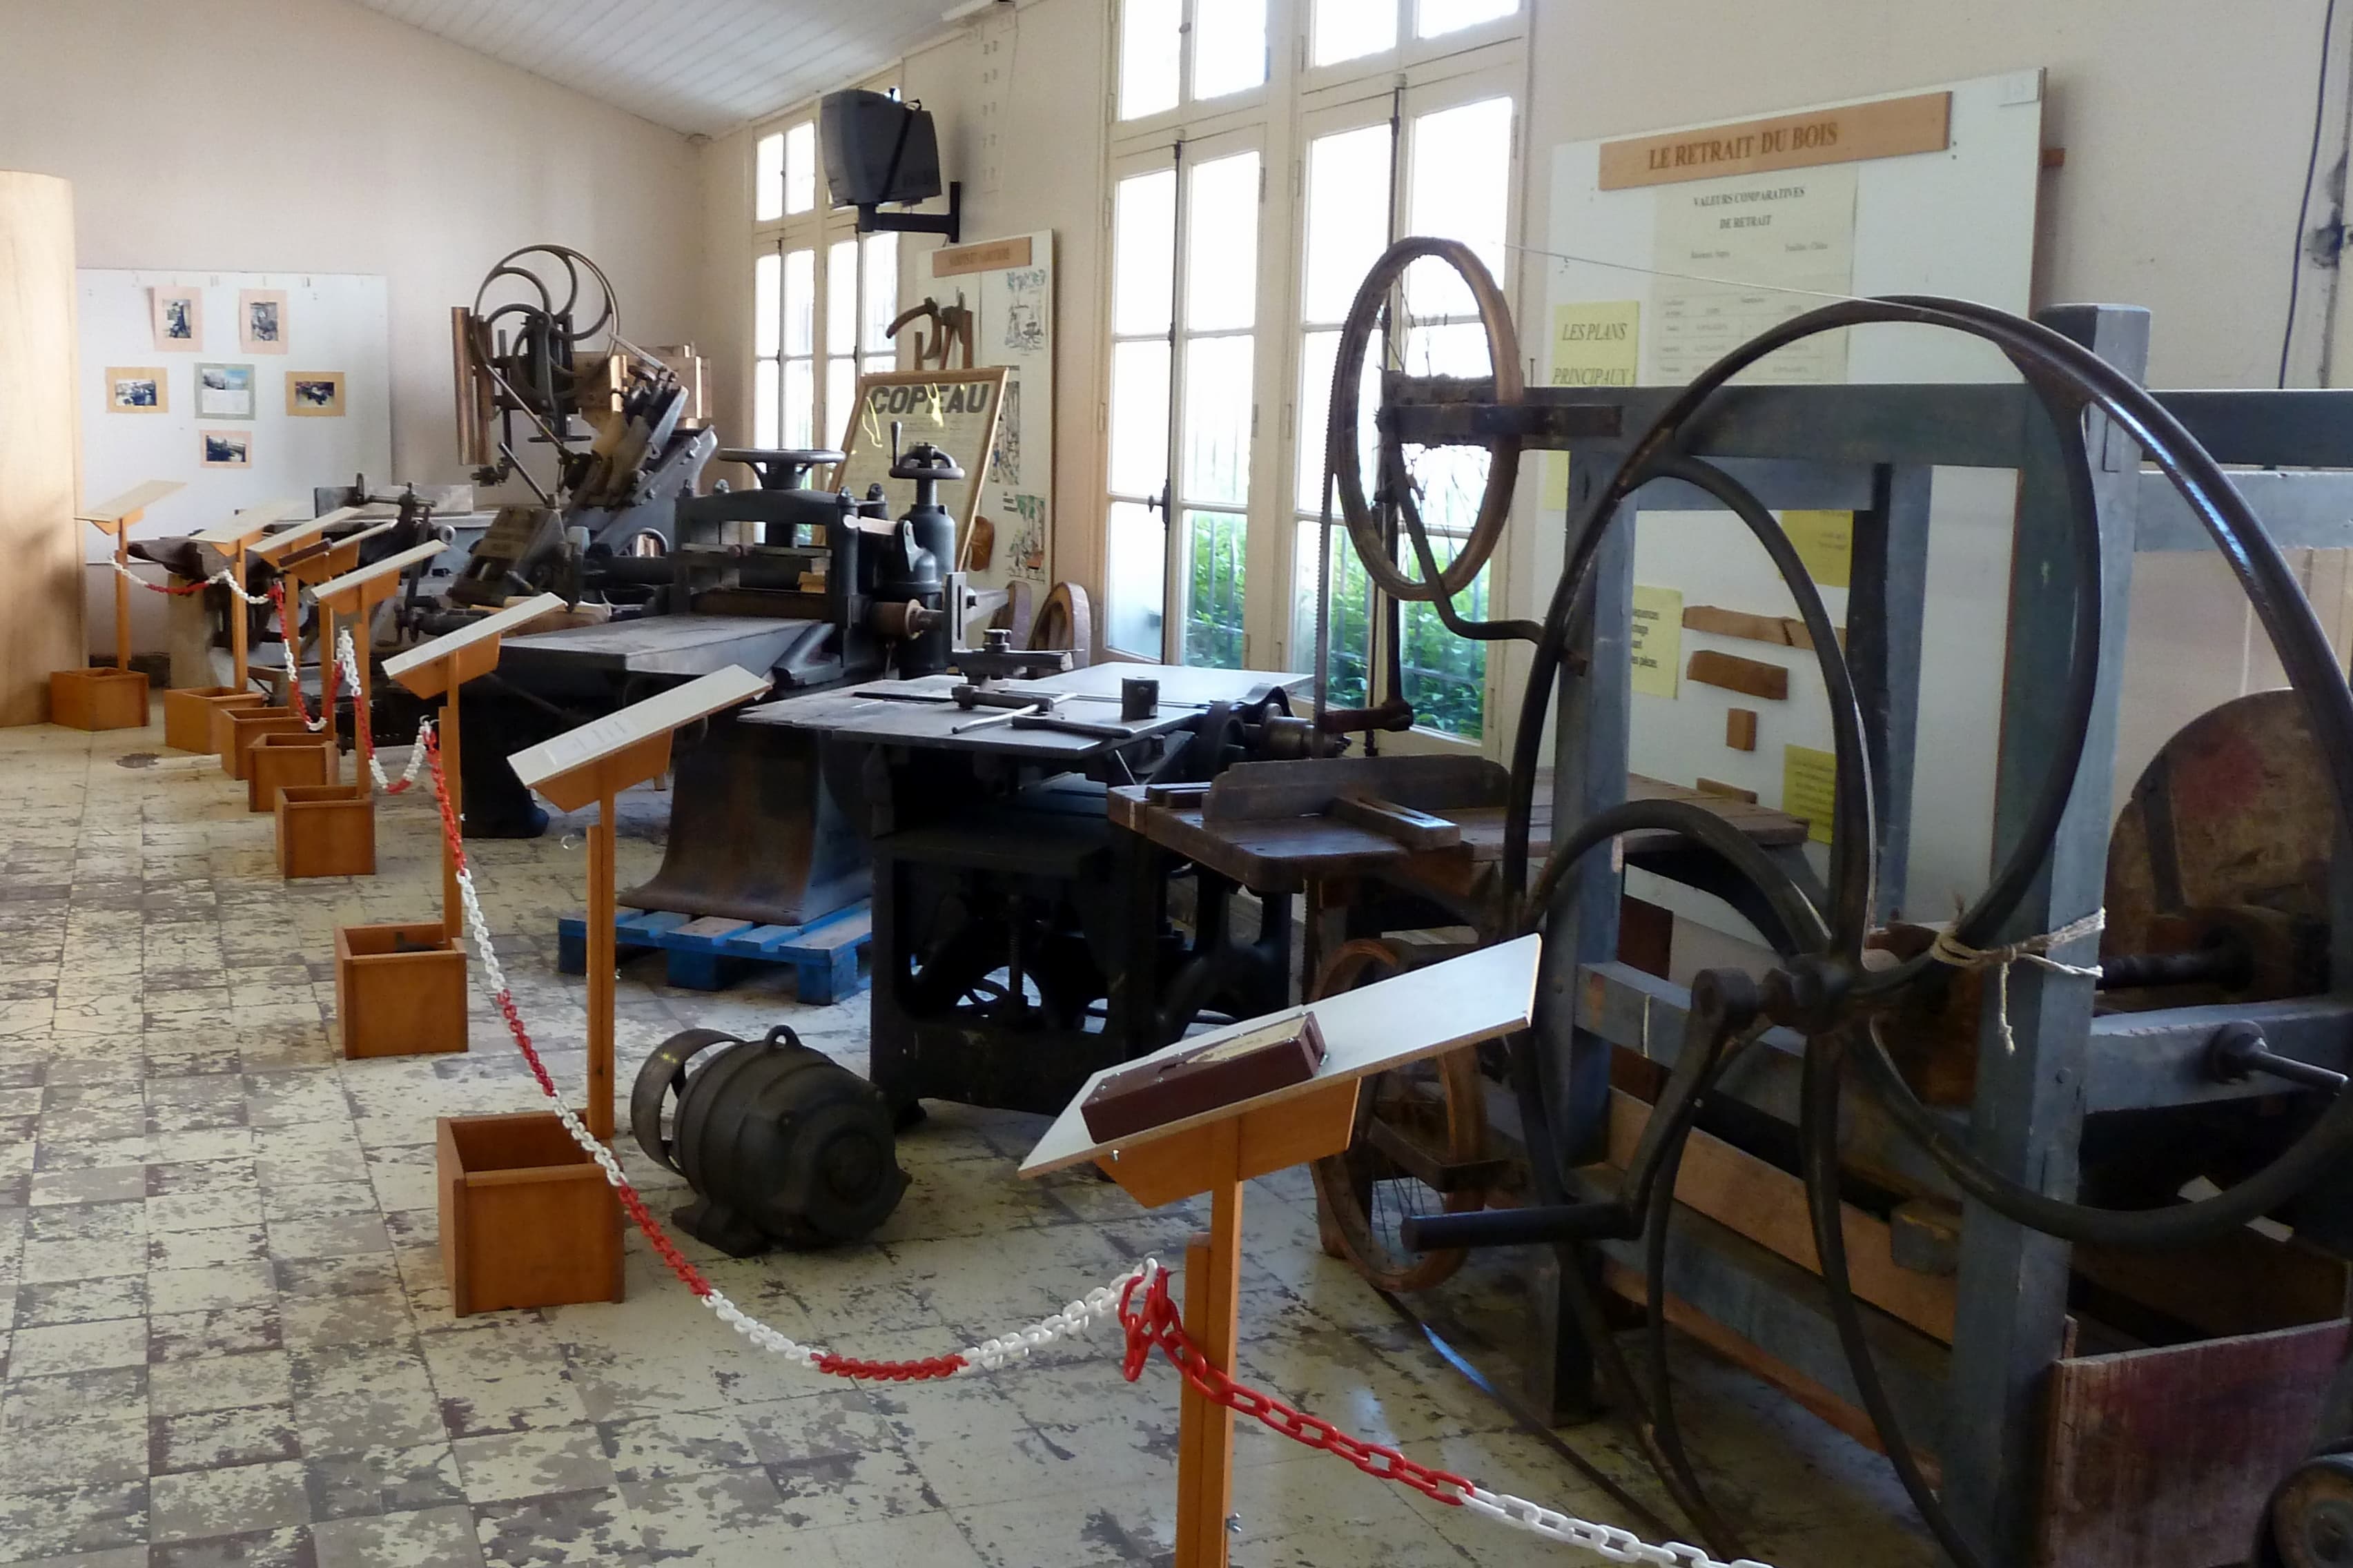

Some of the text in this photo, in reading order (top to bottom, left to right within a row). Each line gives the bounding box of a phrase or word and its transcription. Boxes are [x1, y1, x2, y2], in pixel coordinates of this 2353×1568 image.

[1649, 121, 1838, 170] LE RETRAIT DU BOIS
[1693, 187, 1806, 206] VALEURS COMPARATIVES
[1719, 215, 1773, 229] DE RETRAIT
[1562, 322, 1628, 341] LES PLANS
[1552, 367, 1630, 385] PRINCIPAUX
[868, 383, 989, 415] COPEAU
